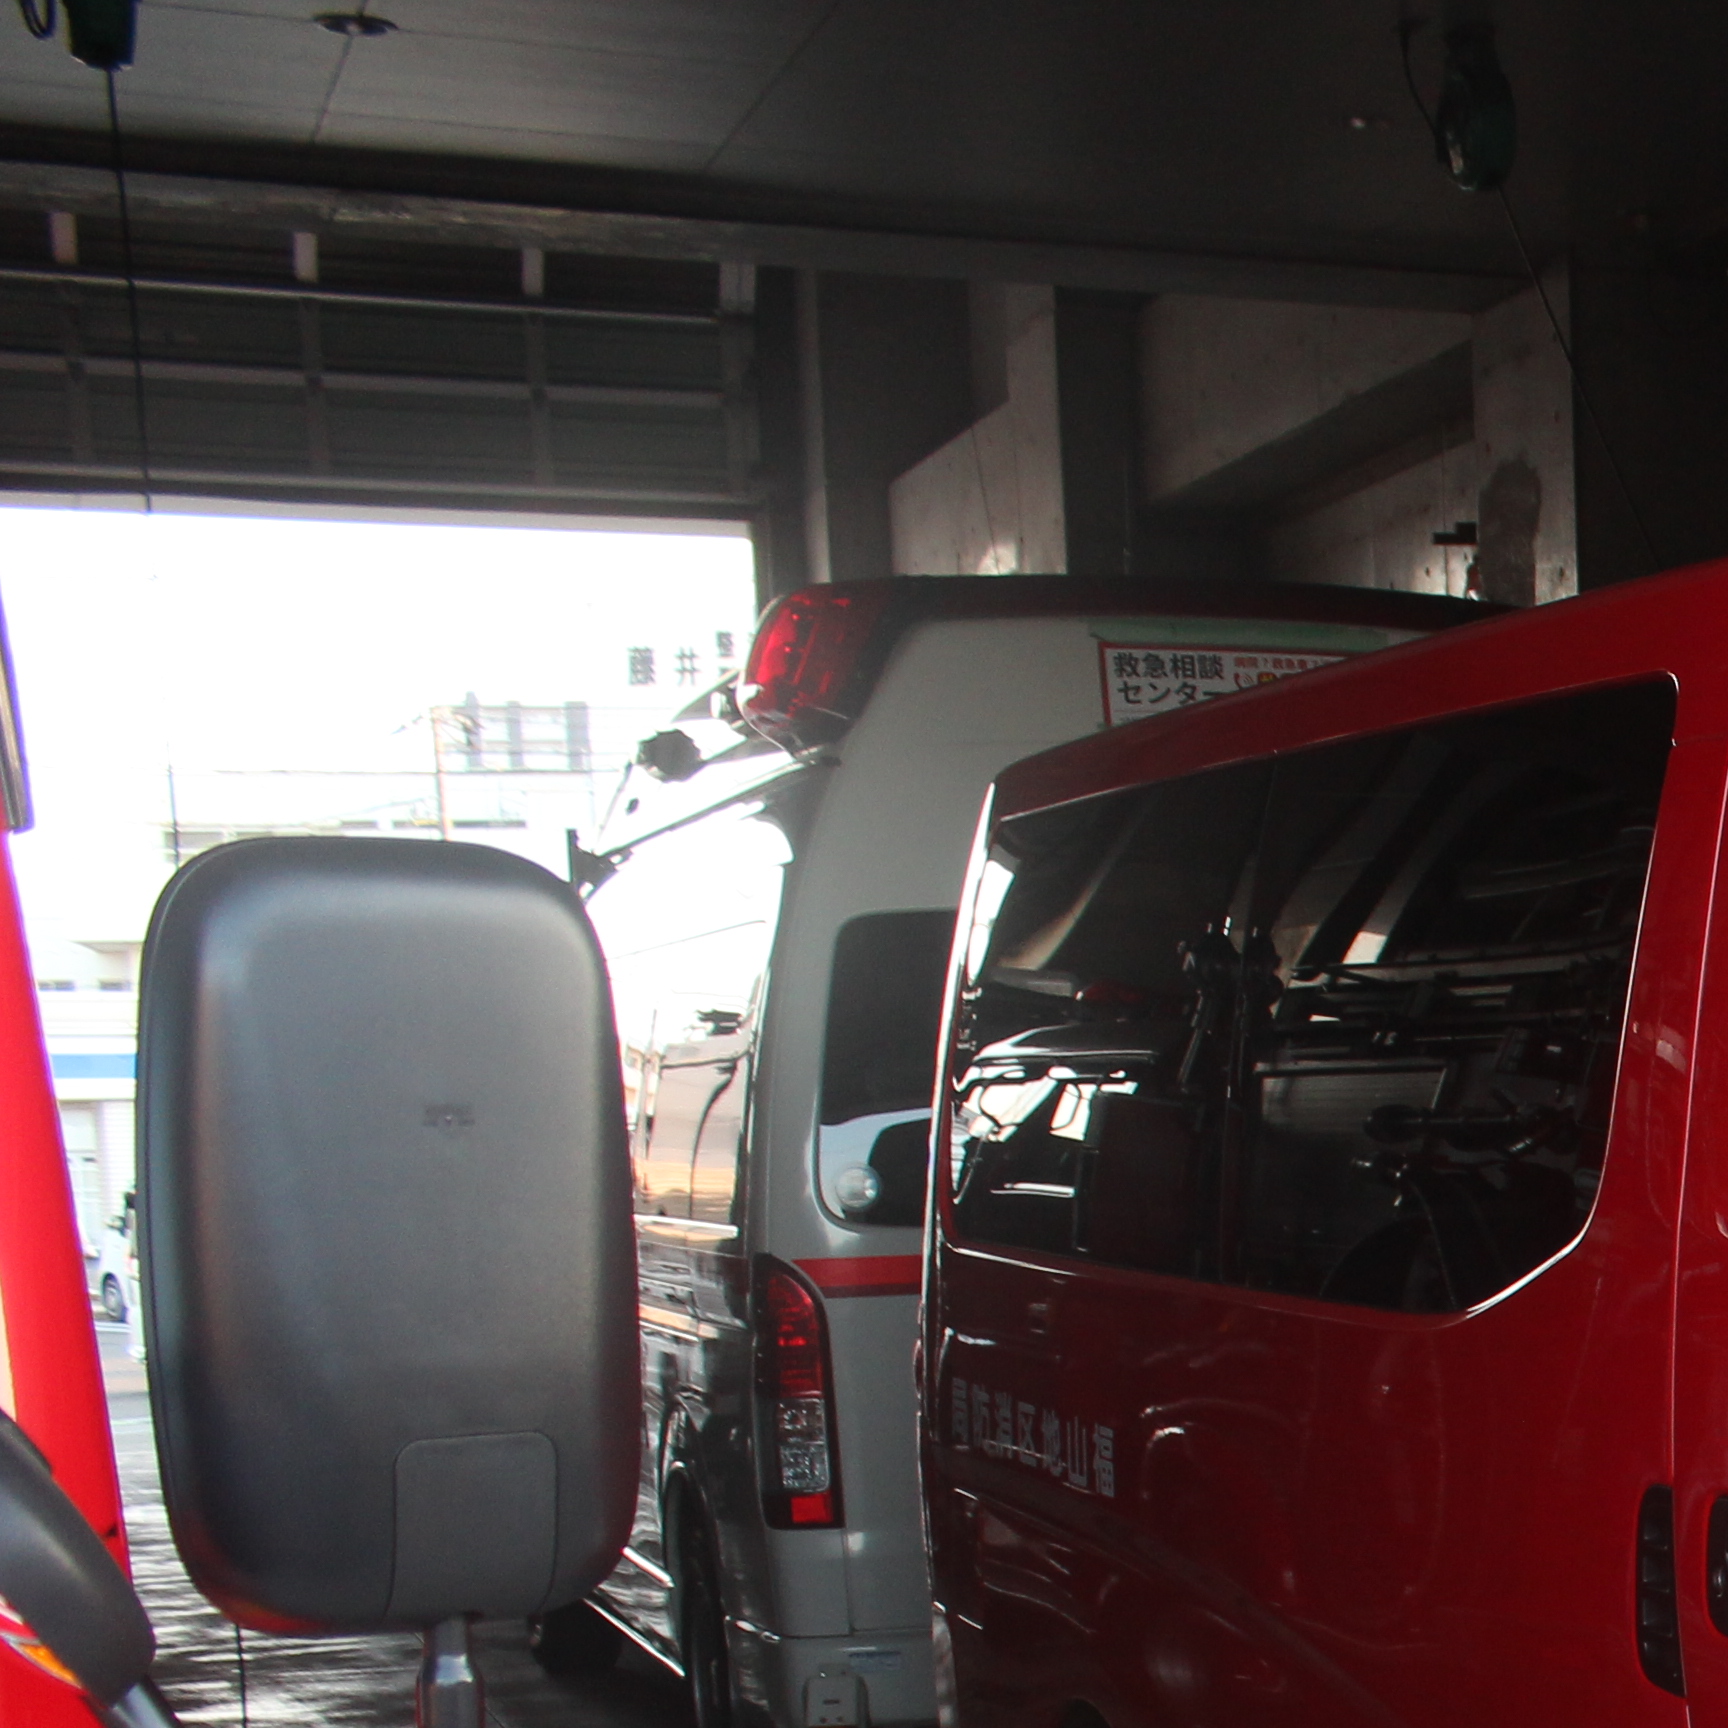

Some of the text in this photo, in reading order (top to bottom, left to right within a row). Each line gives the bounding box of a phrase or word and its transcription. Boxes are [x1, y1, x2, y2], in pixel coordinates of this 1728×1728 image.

[1113, 652, 1225, 680] 救急相談
[1117, 680, 1233, 706] センター
